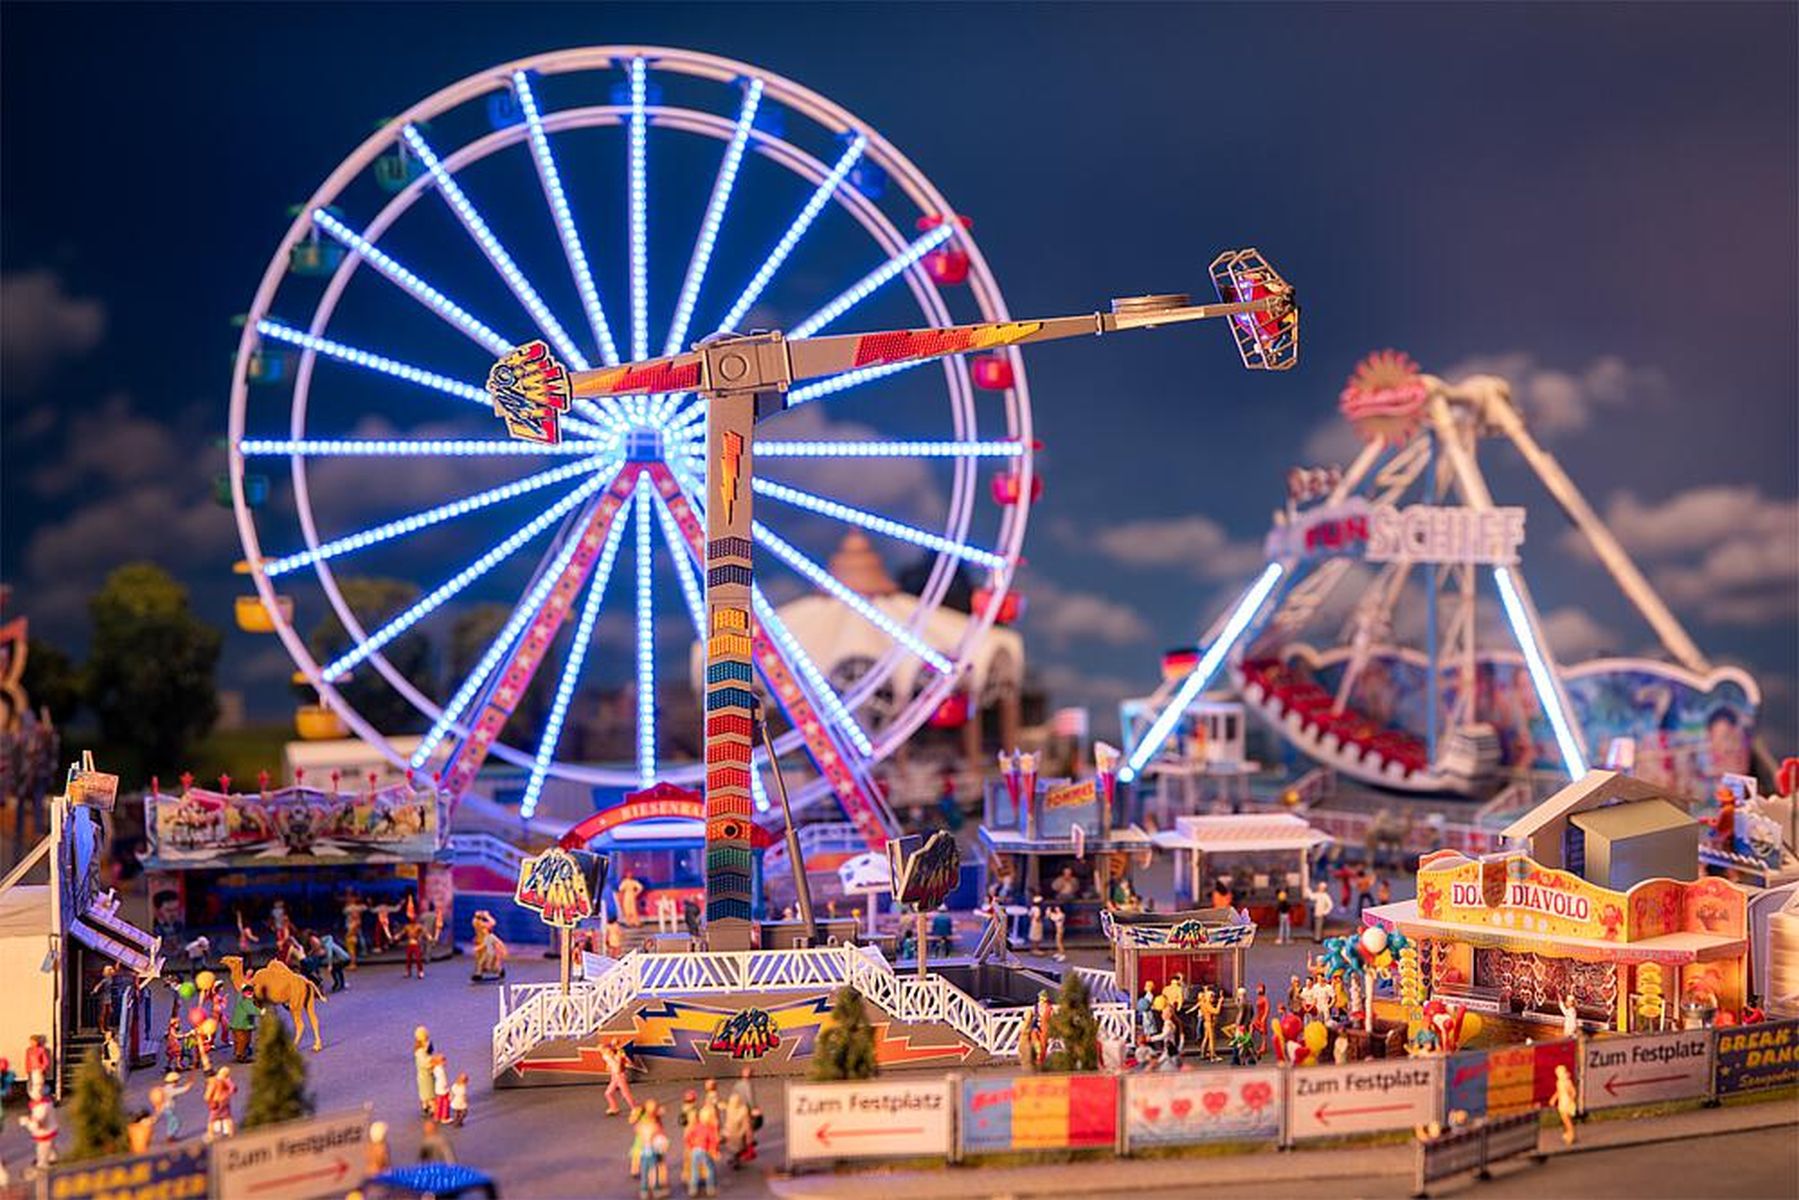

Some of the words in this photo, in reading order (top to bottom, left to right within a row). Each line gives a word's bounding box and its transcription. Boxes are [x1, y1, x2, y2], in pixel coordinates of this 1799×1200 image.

[1305, 515, 1370, 553] FUN
[1366, 504, 1526, 562] SCHIFF
[620, 800, 706, 822] RIESENRA
[1512, 884, 1588, 920] DIAVOLO
[1588, 1049, 1627, 1068] Zum
[1632, 1040, 1705, 1064] Festplatz
[1719, 1027, 1791, 1054] BREAK
[1296, 1077, 1339, 1096] Zum
[1345, 1069, 1430, 1093] Festplatz
[796, 1096, 843, 1115] Zum
[849, 1088, 942, 1115] Festplatz
[227, 1147, 273, 1171] Zum
[276, 1123, 363, 1159] Festplatz
